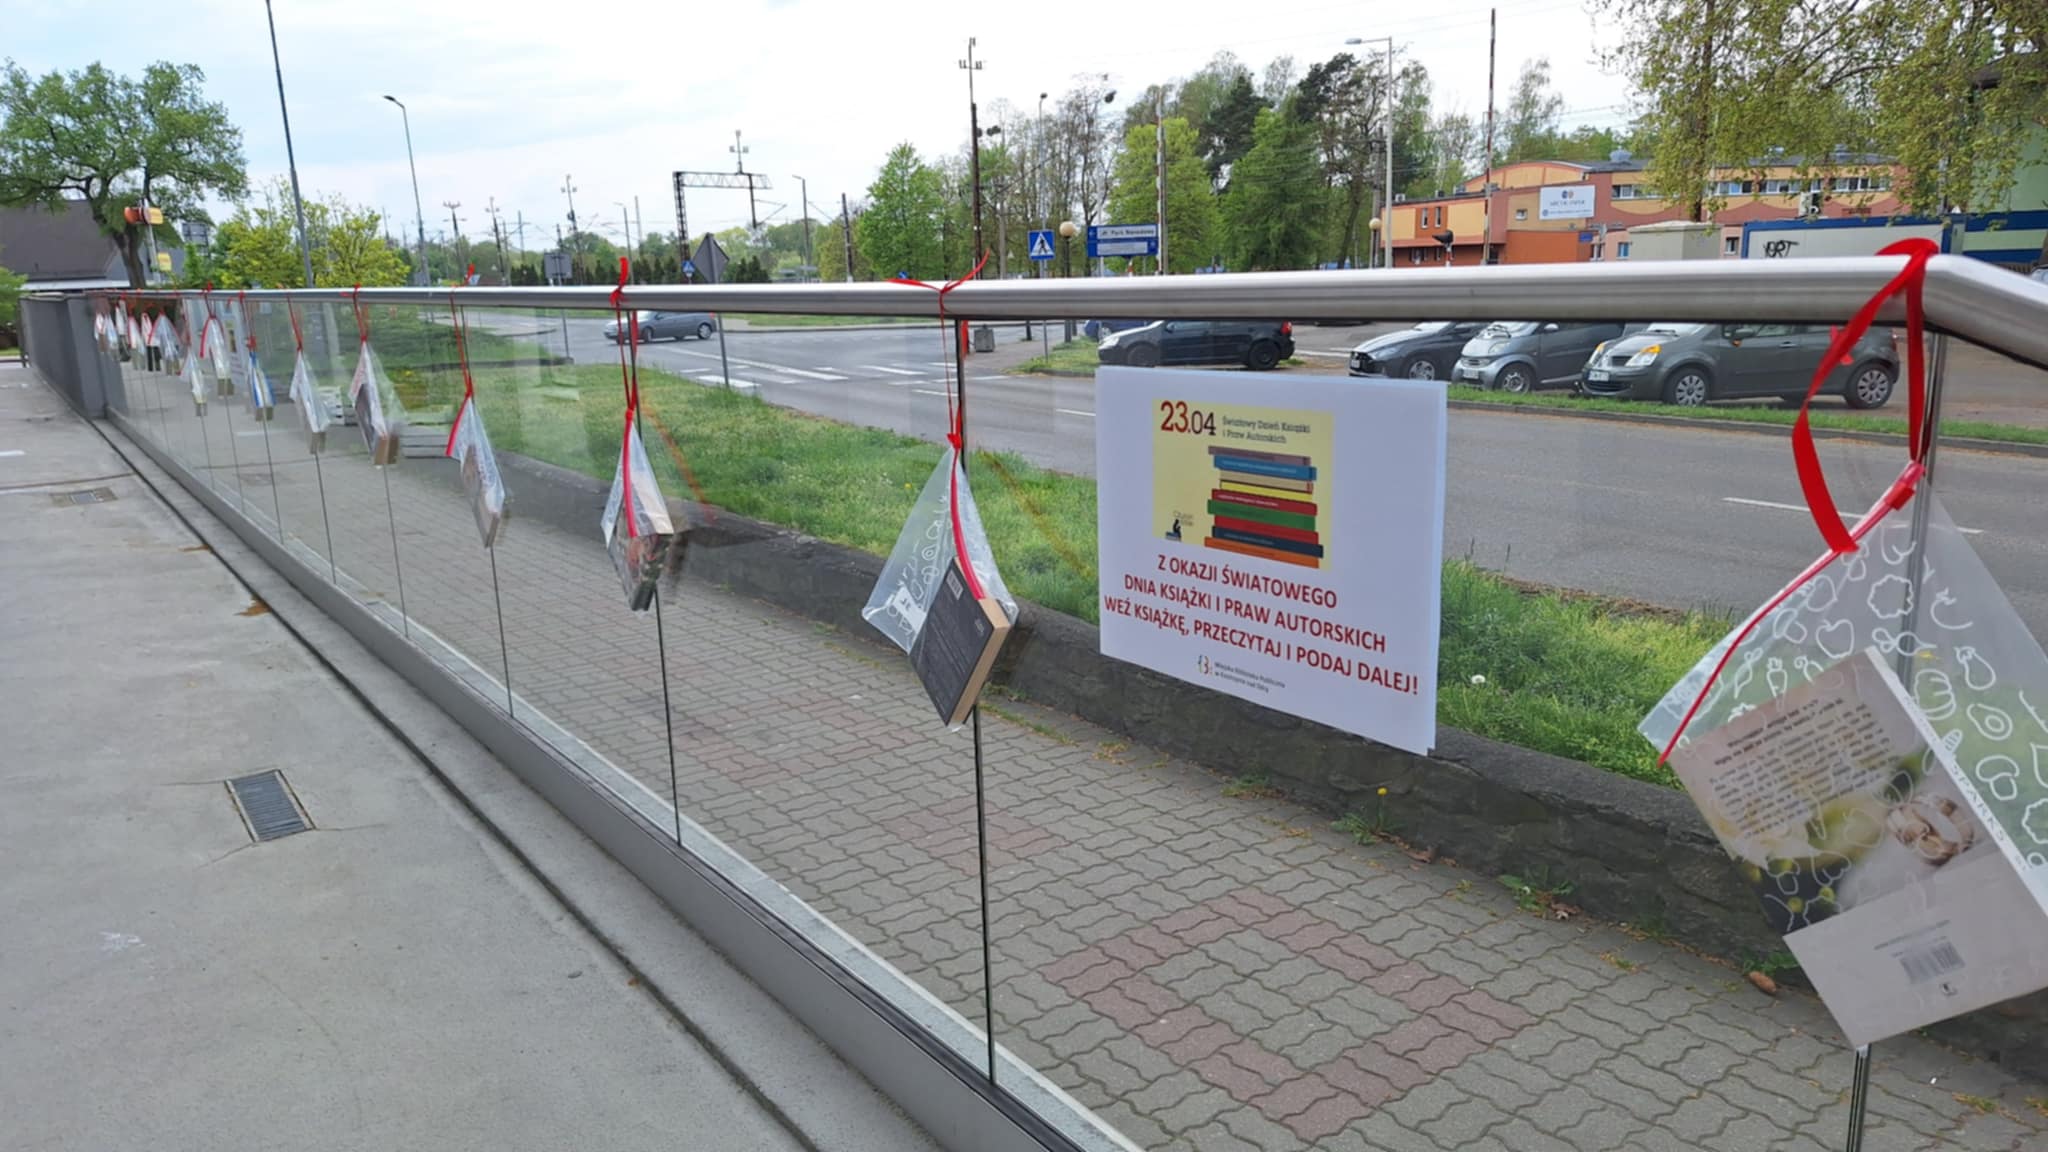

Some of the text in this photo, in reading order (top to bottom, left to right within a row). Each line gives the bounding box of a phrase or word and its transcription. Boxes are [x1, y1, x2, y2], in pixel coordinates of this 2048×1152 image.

[1161, 400, 1216, 436] 23.04
[1124, 574, 1386, 654] DNIA KSIĄŻKI I PRAW AUTORSKICH
[1158, 554, 1337, 609] Z OKAZJI ŚWIATOWEGO
[1104, 595, 1418, 696] WEŹ KSIĄŻKĘ, PRZECZYTAJ I PODAJ DALEJ!
